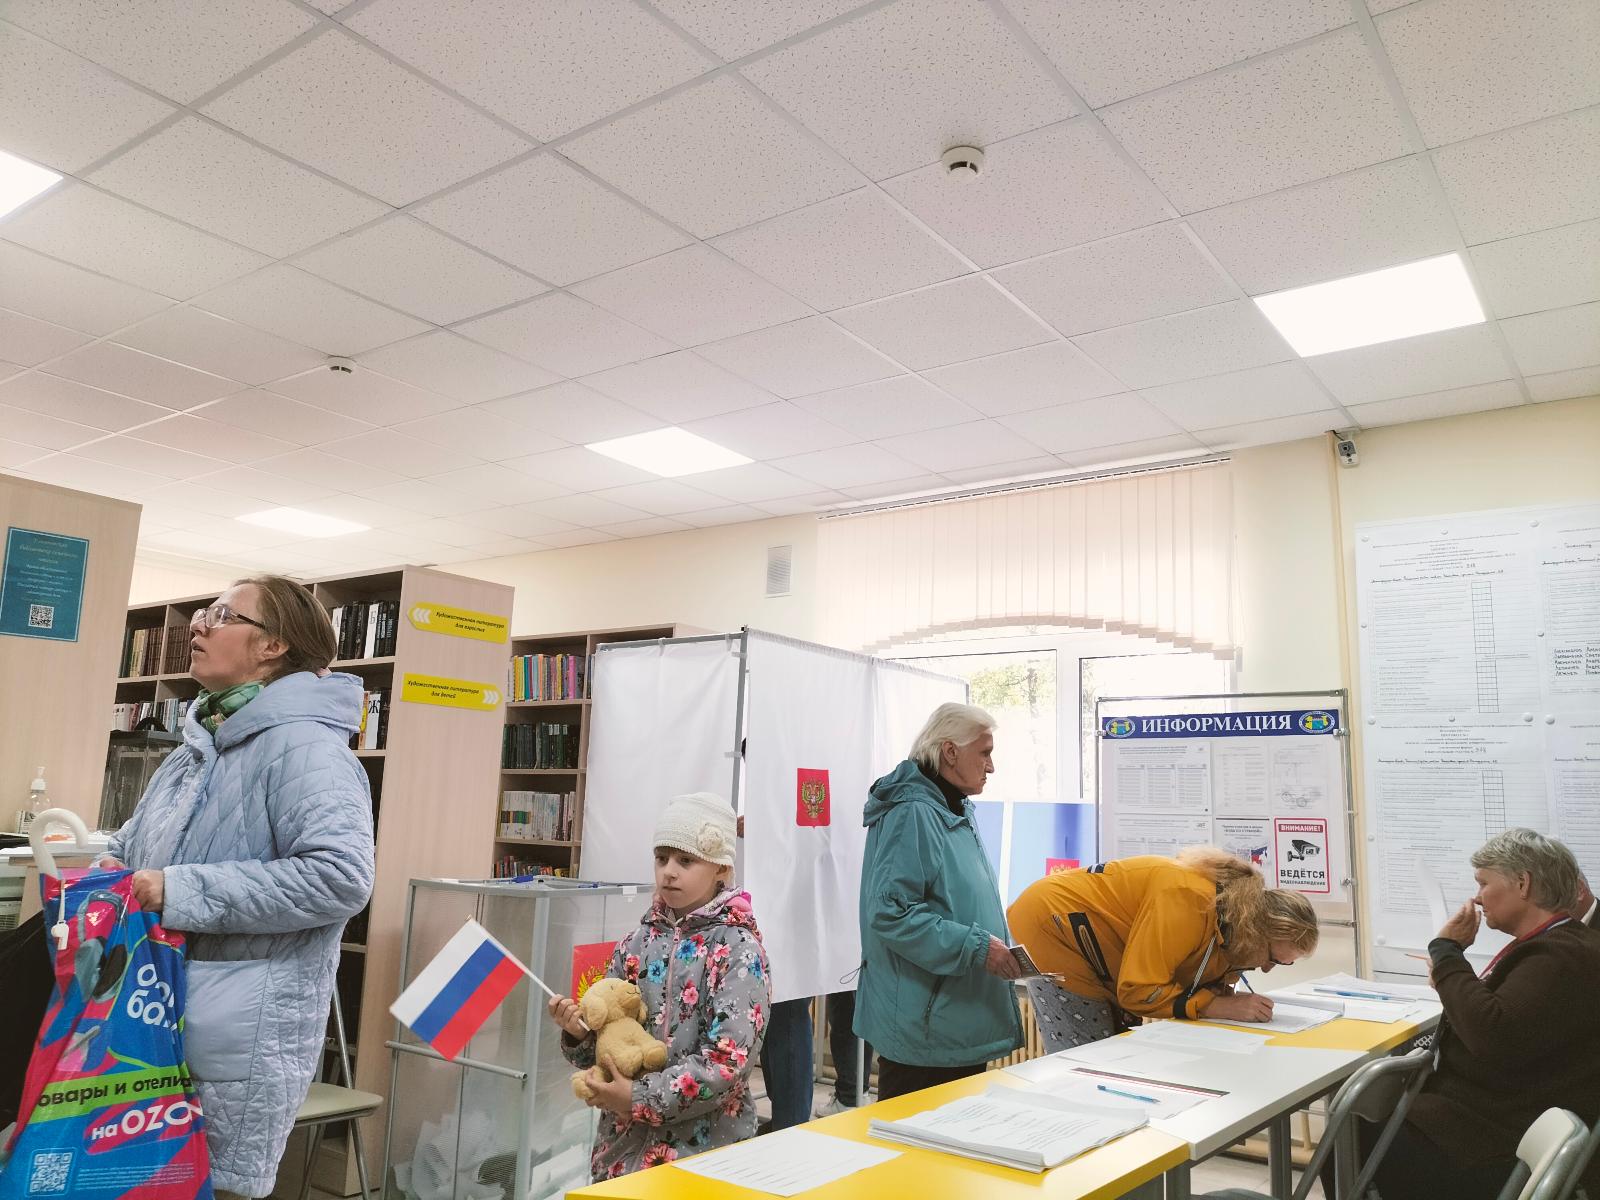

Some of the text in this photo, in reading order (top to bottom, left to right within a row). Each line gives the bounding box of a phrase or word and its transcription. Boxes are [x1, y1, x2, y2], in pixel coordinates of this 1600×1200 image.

[1142, 715, 1292, 734] ИНФОРМАЦИЯ
[1280, 824, 1321, 832] ВНИМАНИЕ!
[1280, 867, 1325, 879] ВЕДЁТСЯ
[38, 1085, 108, 1108] овары
[114, 1080, 127, 1095] и
[91, 1123, 118, 1140] на
